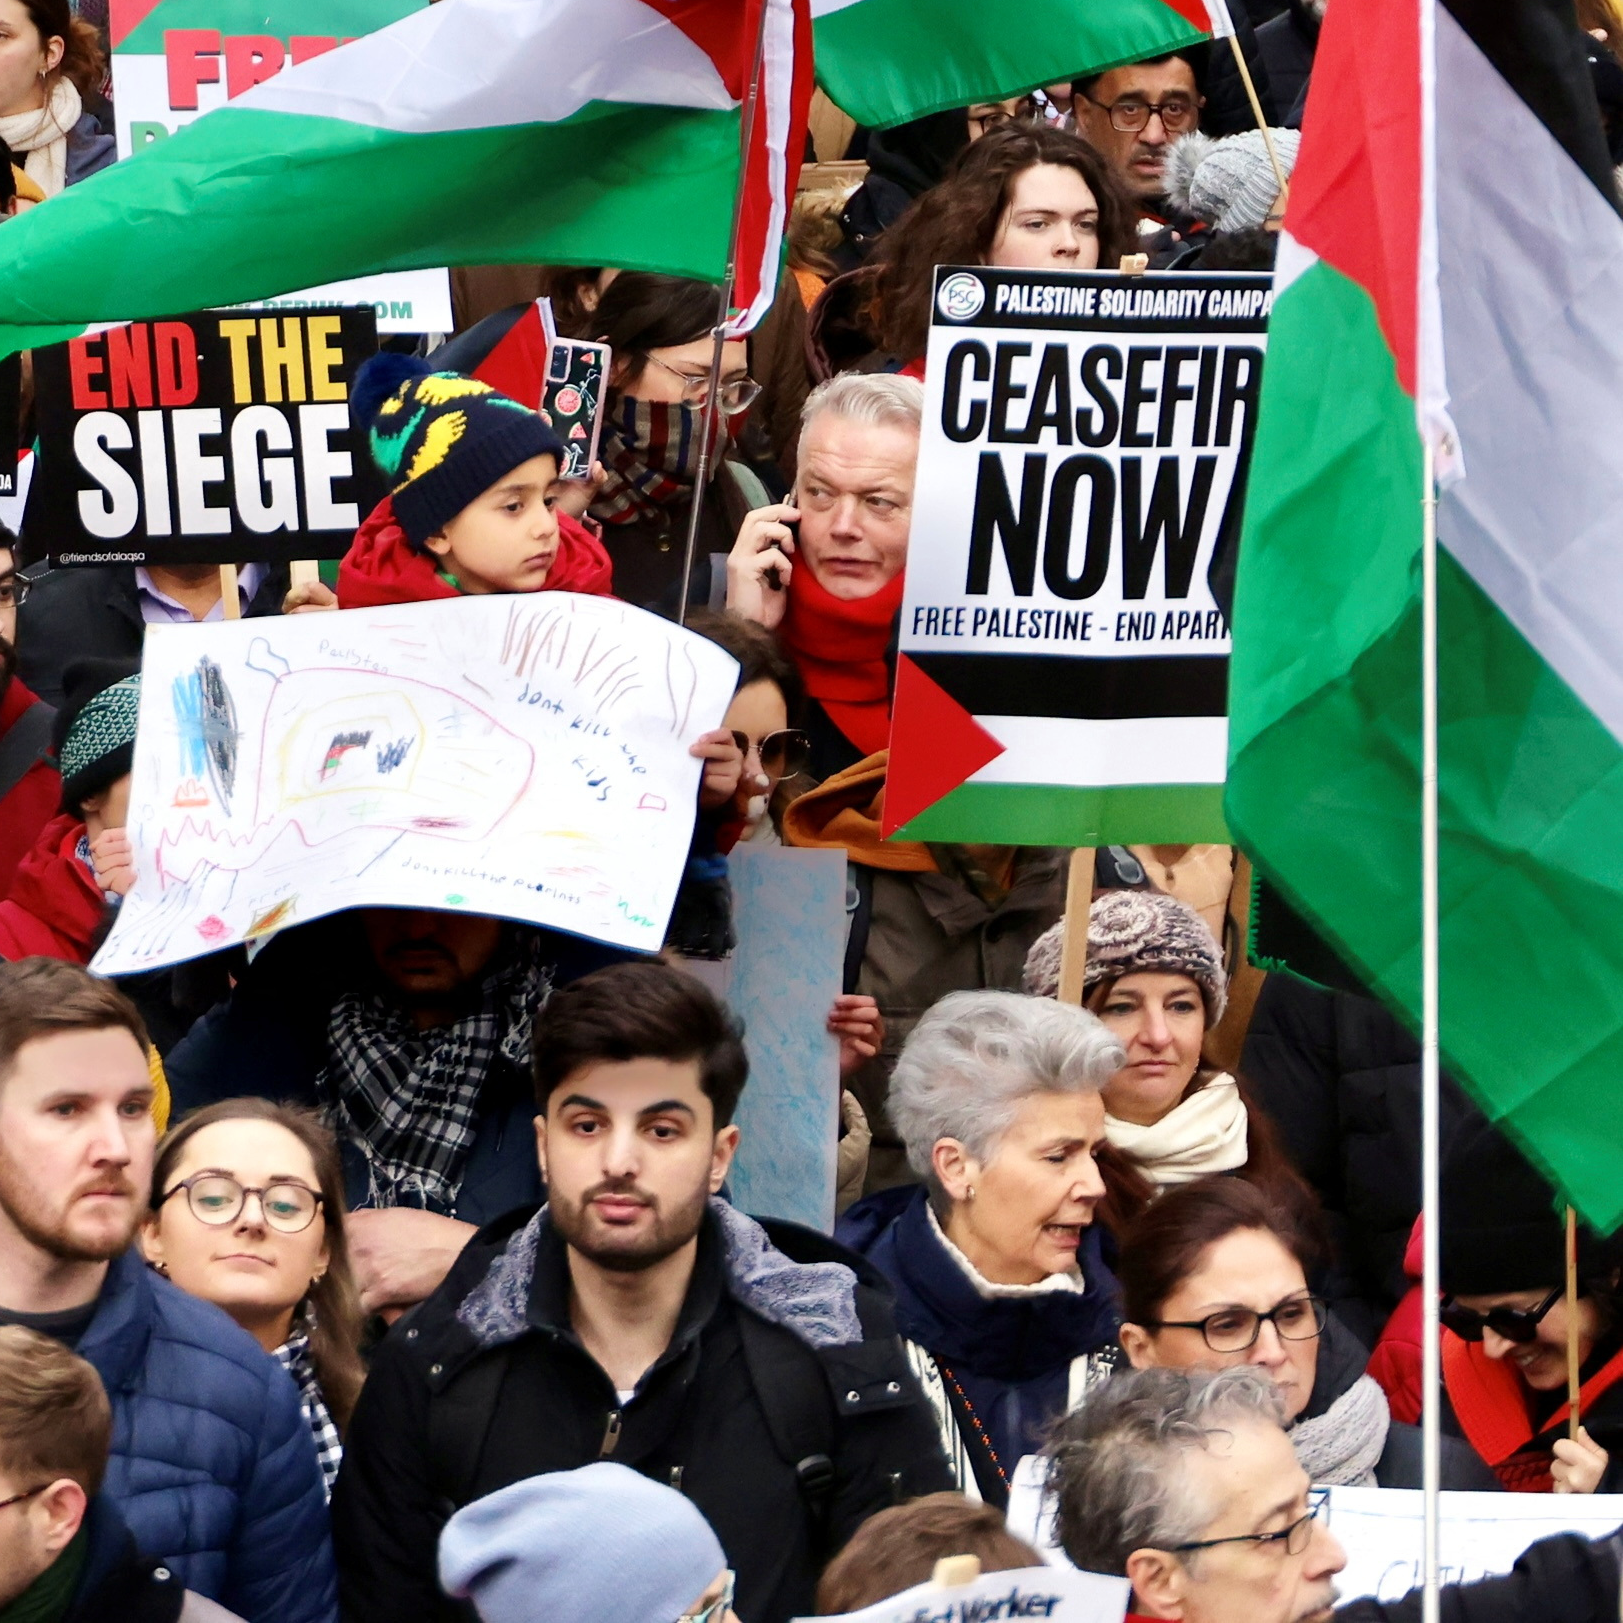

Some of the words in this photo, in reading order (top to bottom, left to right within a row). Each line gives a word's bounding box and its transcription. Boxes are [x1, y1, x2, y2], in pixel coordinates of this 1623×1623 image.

[68, 321, 198, 411] END
[220, 315, 343, 406] THE
[74, 404, 359, 540] SIEGE
